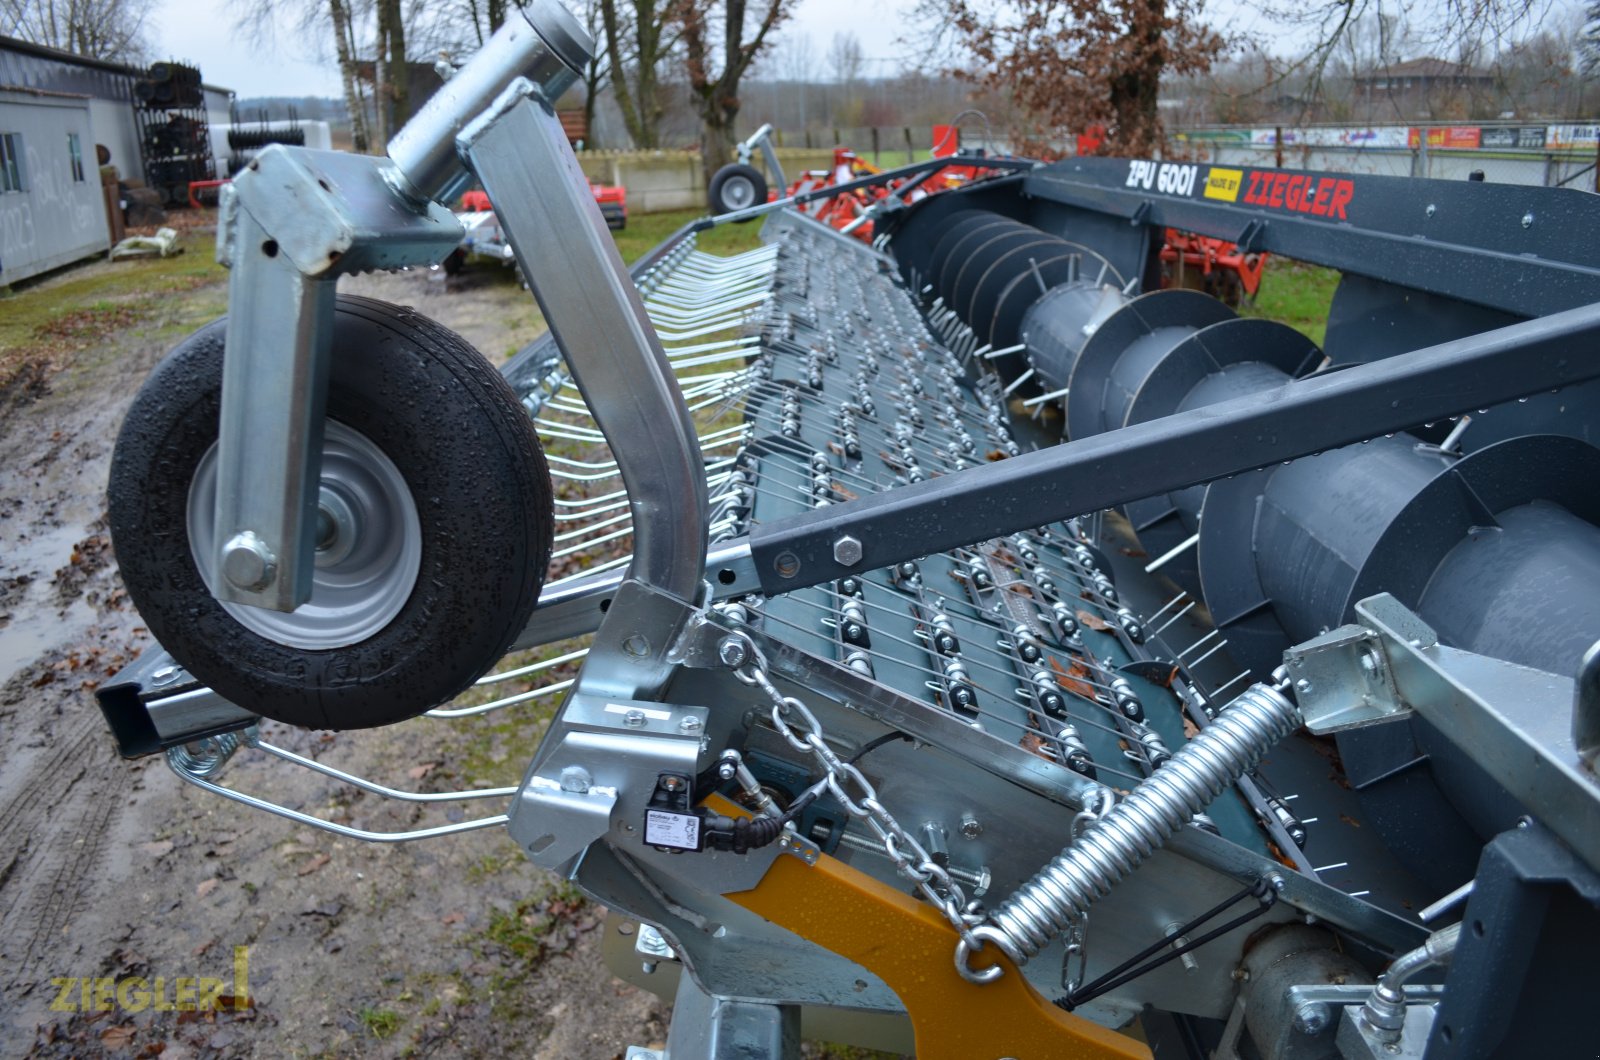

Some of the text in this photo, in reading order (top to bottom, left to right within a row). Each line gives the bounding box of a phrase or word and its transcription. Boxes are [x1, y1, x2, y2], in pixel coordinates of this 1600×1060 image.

[1125, 160, 1198, 197] ZPU 6001
[1209, 177, 1238, 191] MADE BY
[1243, 170, 1354, 220] ZIEGLER
